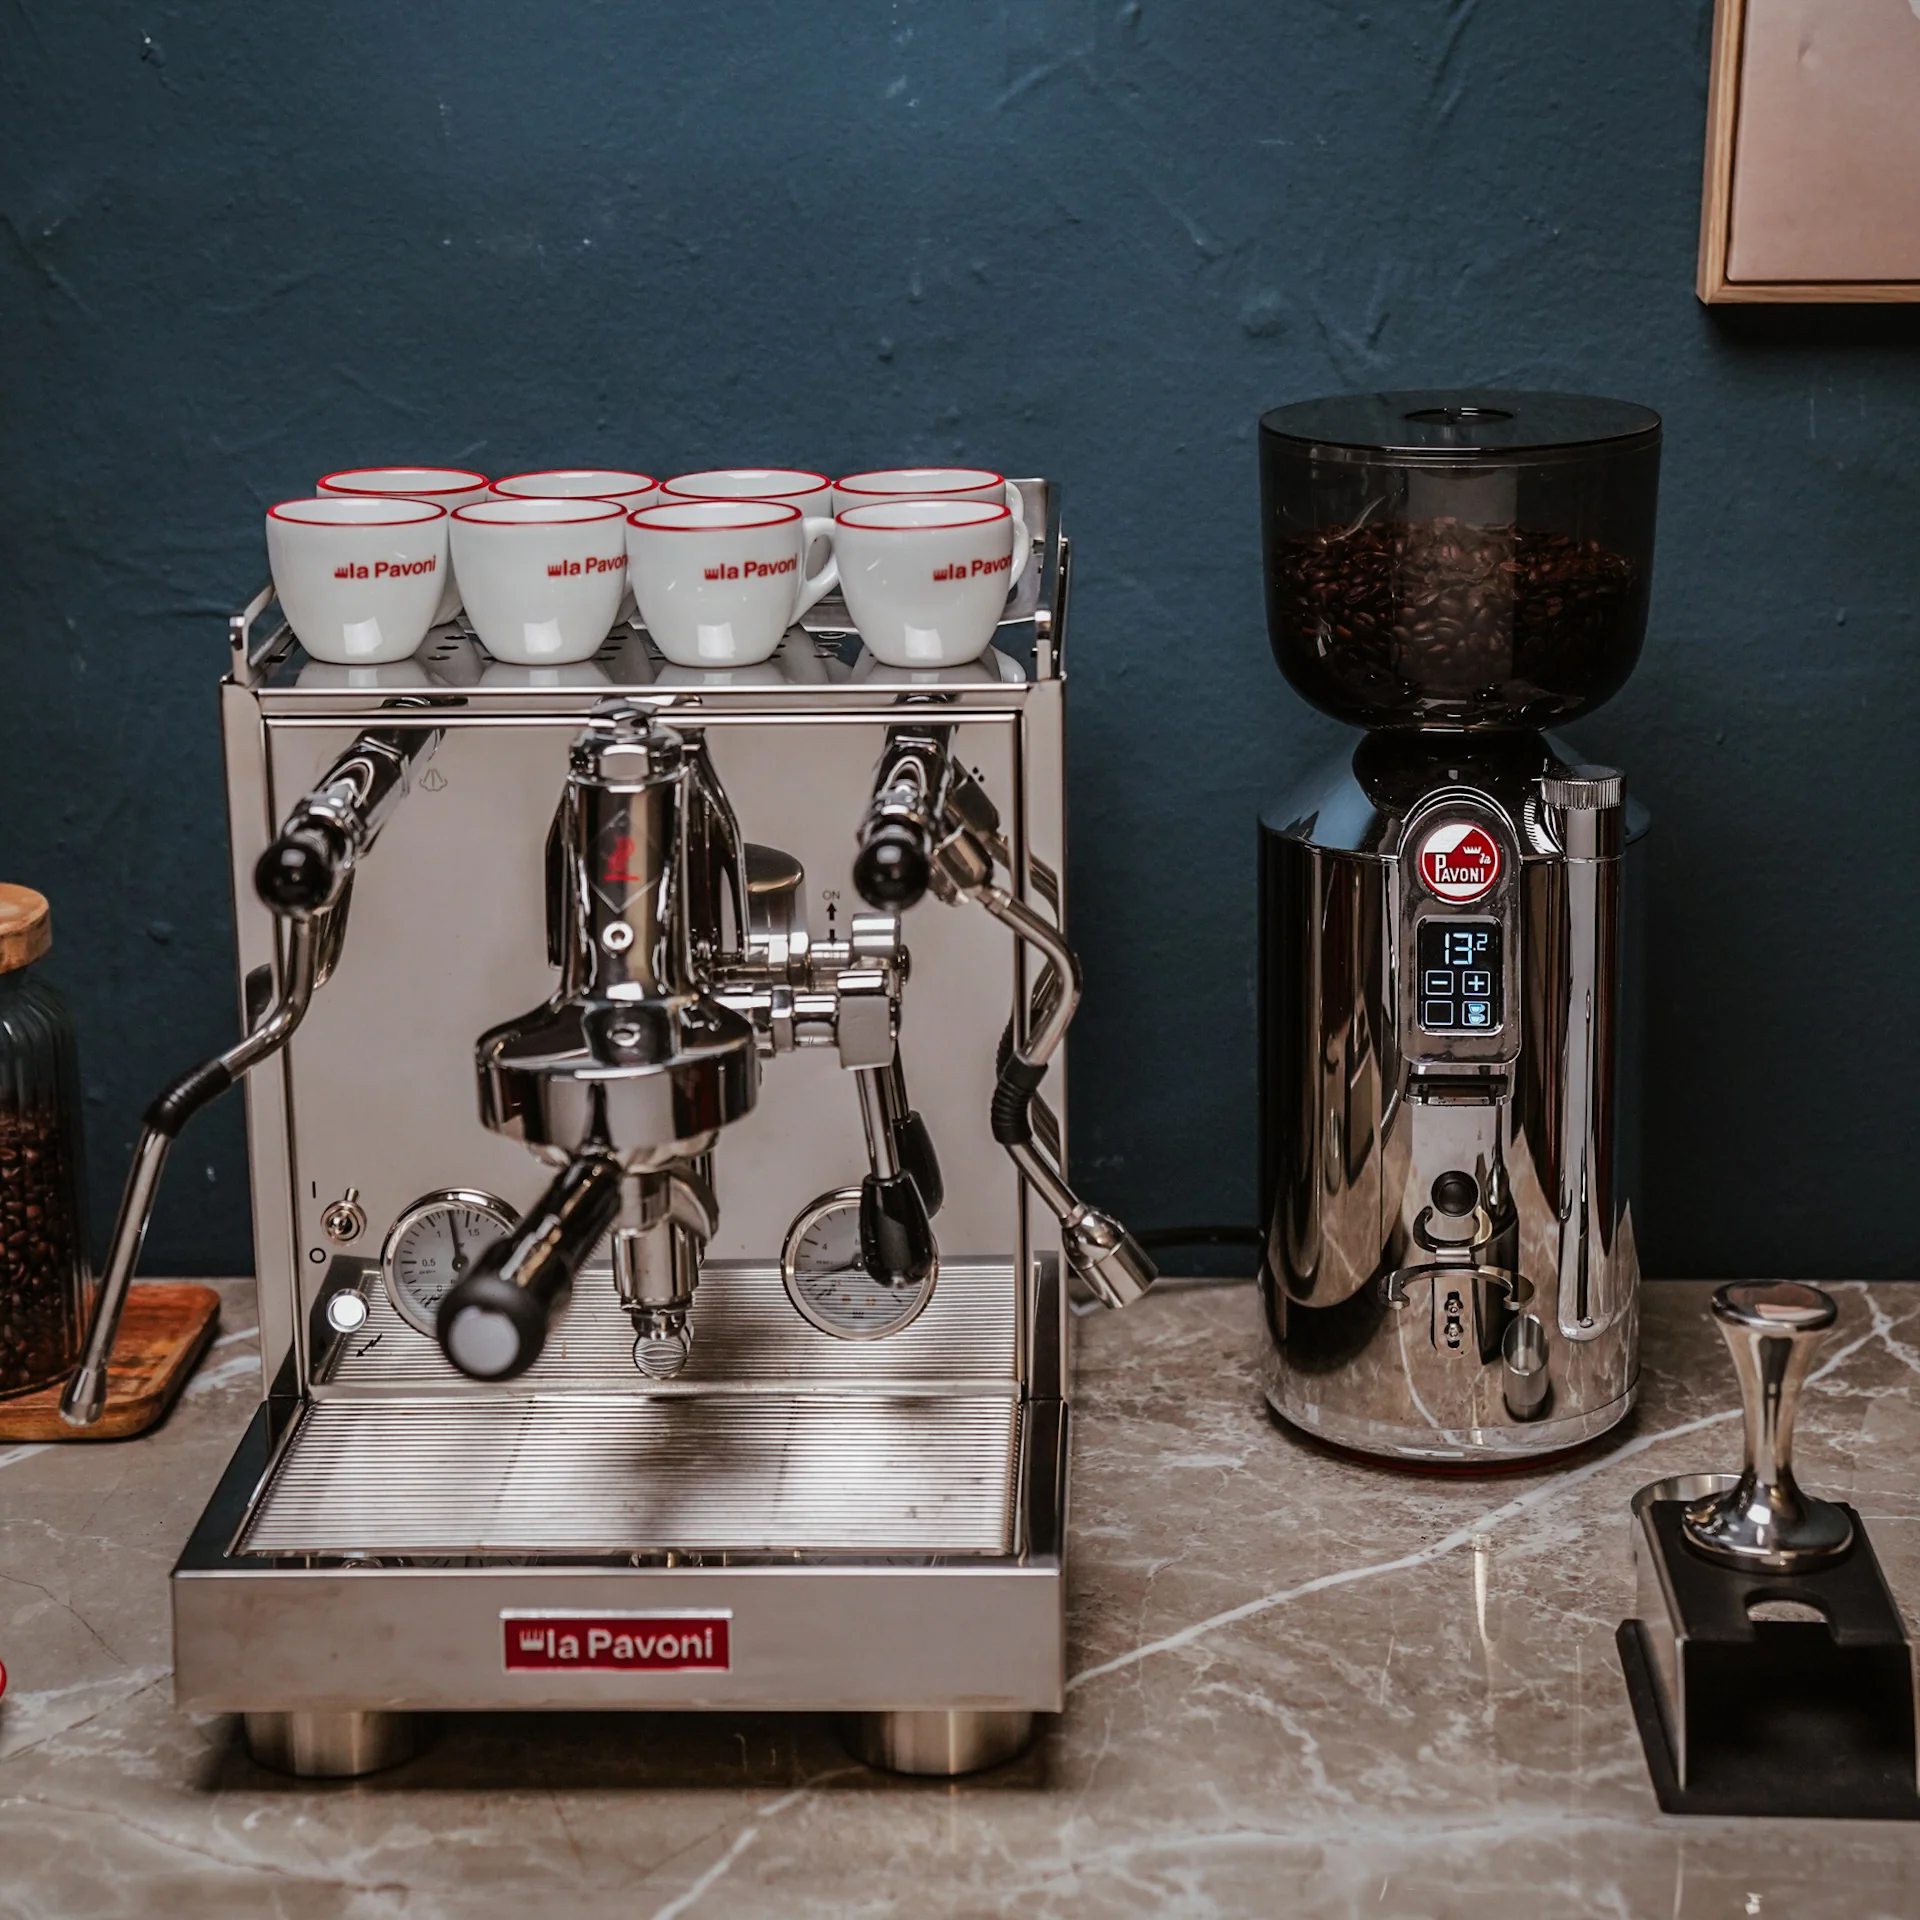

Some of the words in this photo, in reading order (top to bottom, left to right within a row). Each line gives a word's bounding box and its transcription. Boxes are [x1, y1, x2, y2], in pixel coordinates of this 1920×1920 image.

[350, 562, 369, 579] la
[374, 554, 436, 579] Pavoni
[563, 560, 581, 576] la
[585, 554, 628, 575] Pavon
[720, 562, 739, 580] la
[744, 552, 798, 578] Pavoni
[949, 563, 967, 580] la
[1479, 853, 1491, 864] la
[822, 890, 840, 900] ON
[468, 1228, 480, 1236] 1.5
[422, 1259, 436, 1267] 0.5
[546, 1628, 580, 1659] la
[587, 1627, 714, 1660] Pavoni
